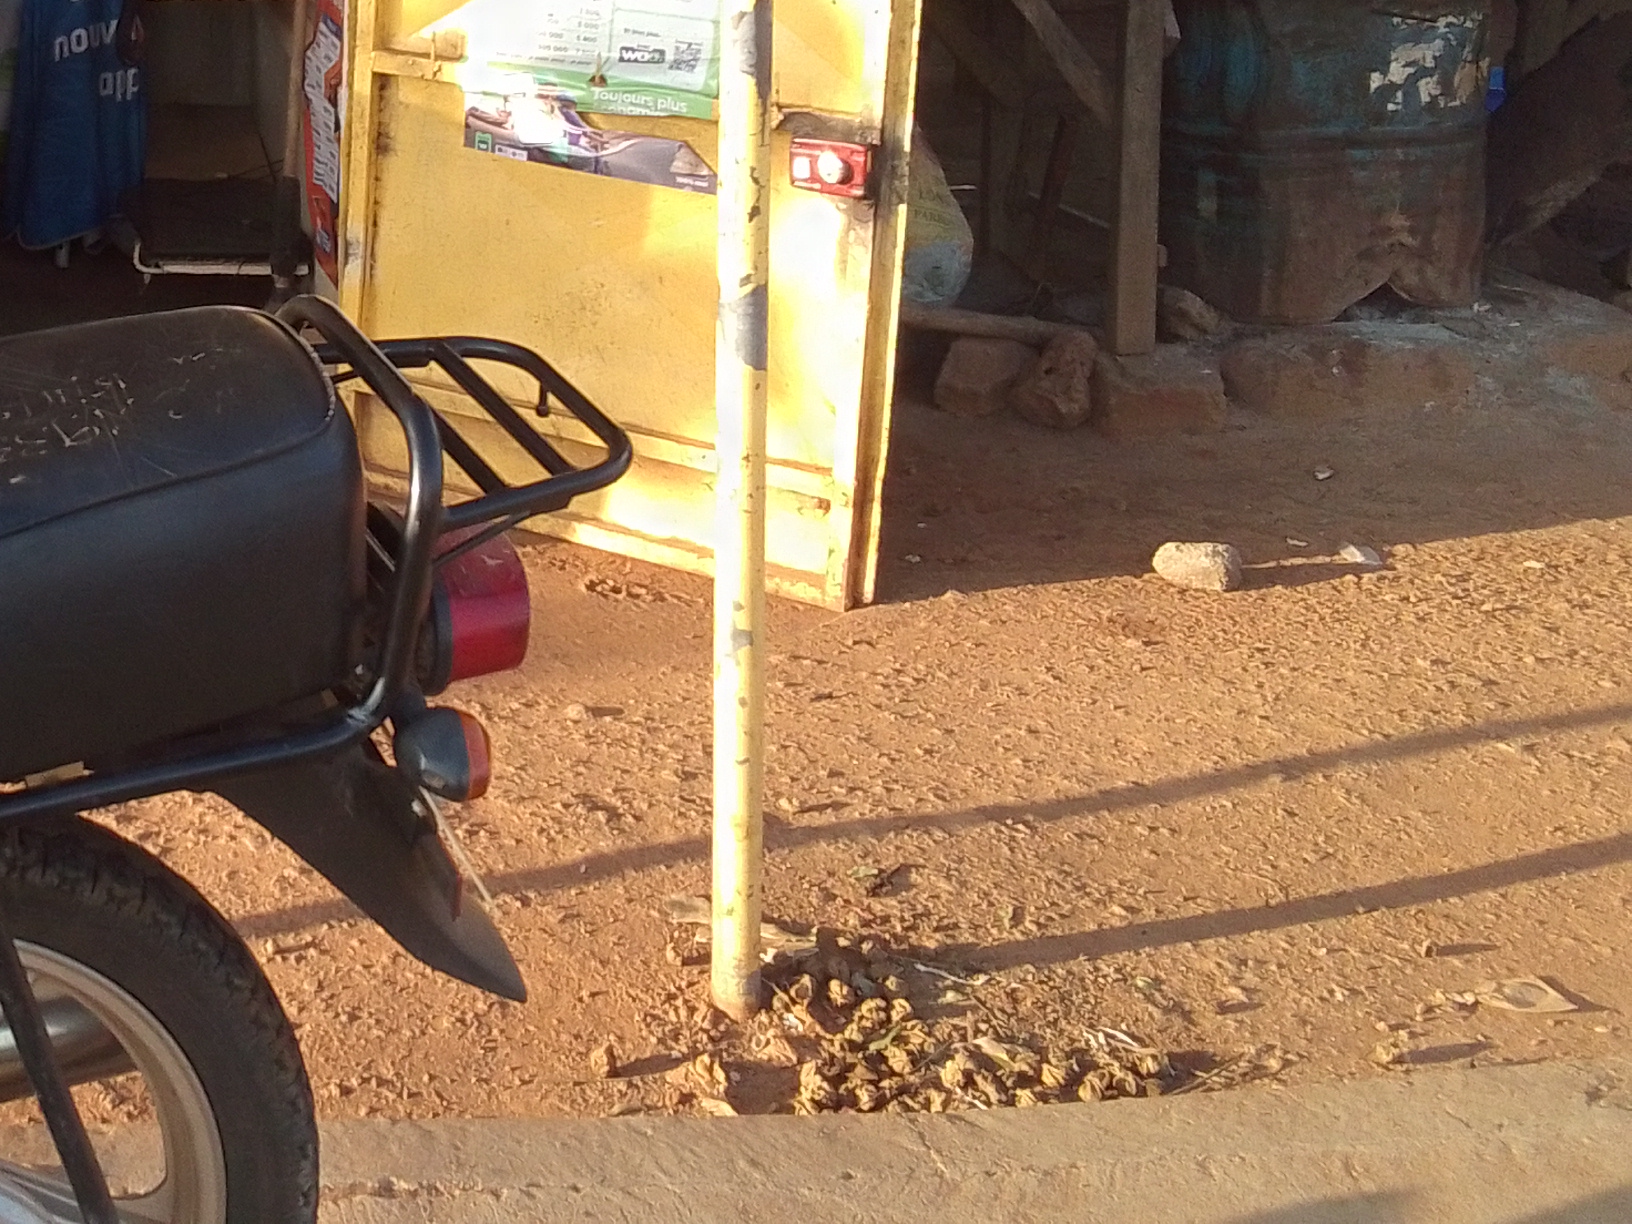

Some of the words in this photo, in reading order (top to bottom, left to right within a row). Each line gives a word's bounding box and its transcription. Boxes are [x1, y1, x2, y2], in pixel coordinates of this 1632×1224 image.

[54, 19, 119, 62] nouv
[591, 88, 654, 106] Toujours
[657, 97, 687, 113] plus
